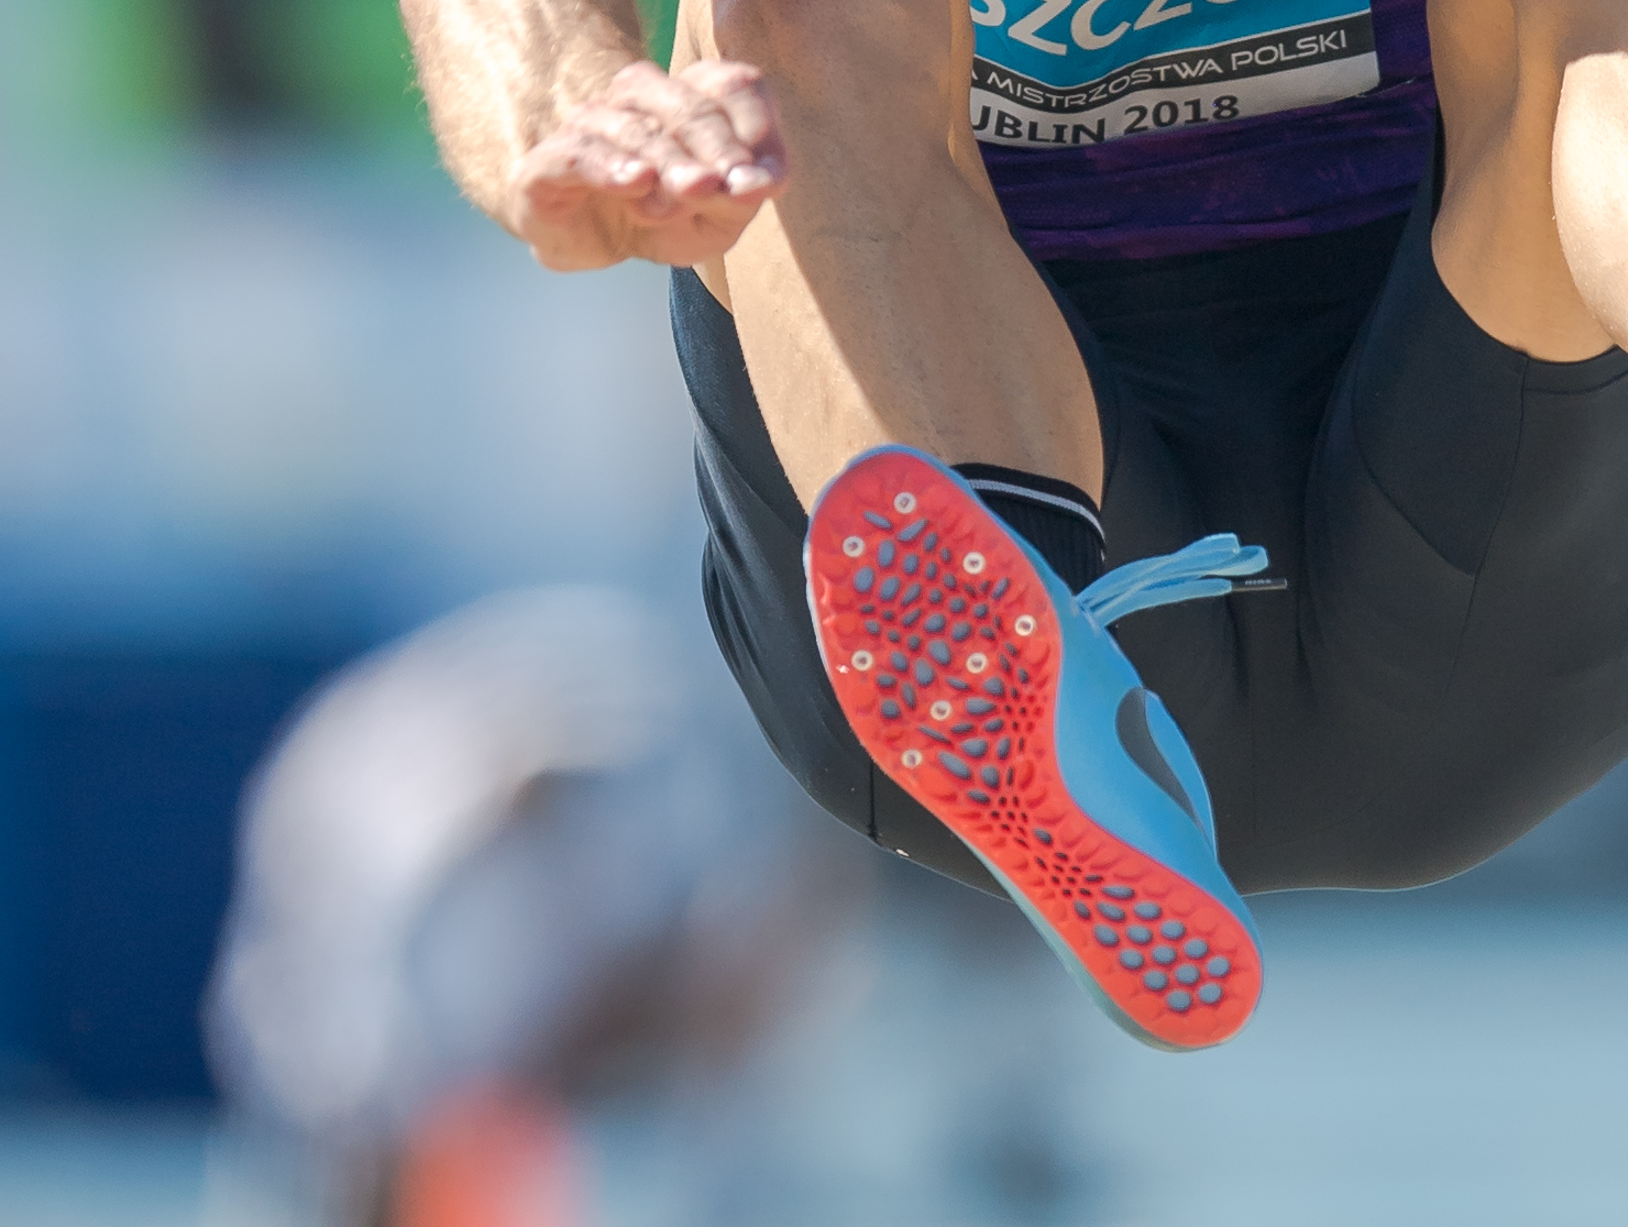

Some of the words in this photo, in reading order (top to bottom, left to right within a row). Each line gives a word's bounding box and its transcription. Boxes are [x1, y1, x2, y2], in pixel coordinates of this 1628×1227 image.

[987, 59, 1223, 108] MISTRZOSTWA
[1231, 29, 1347, 71] POLSKI
[1123, 95, 1239, 135] 2018
